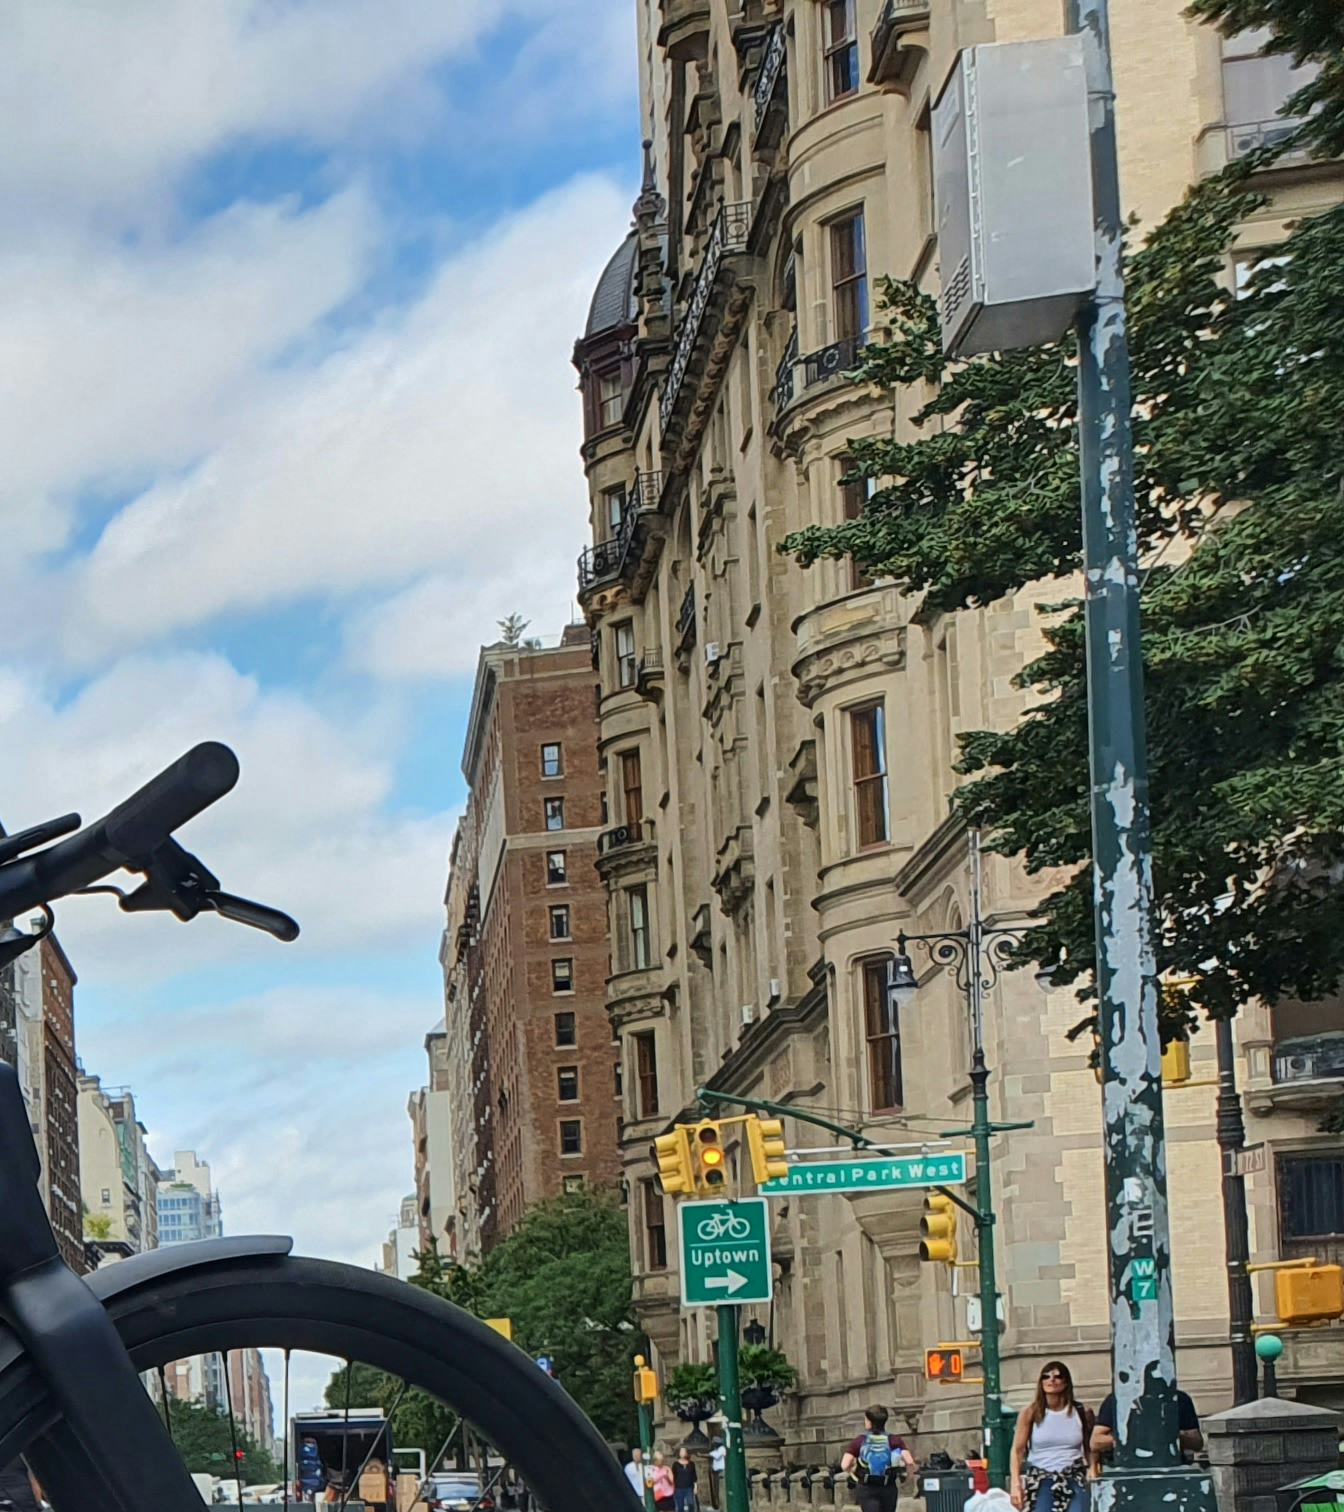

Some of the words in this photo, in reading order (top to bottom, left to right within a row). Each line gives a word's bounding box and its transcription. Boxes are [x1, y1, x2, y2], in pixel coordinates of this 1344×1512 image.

[852, 1166, 901, 1181] Park
[908, 1161, 959, 1178] West
[692, 1248, 759, 1268] Uptown
[1138, 1282, 1151, 1298] 7
